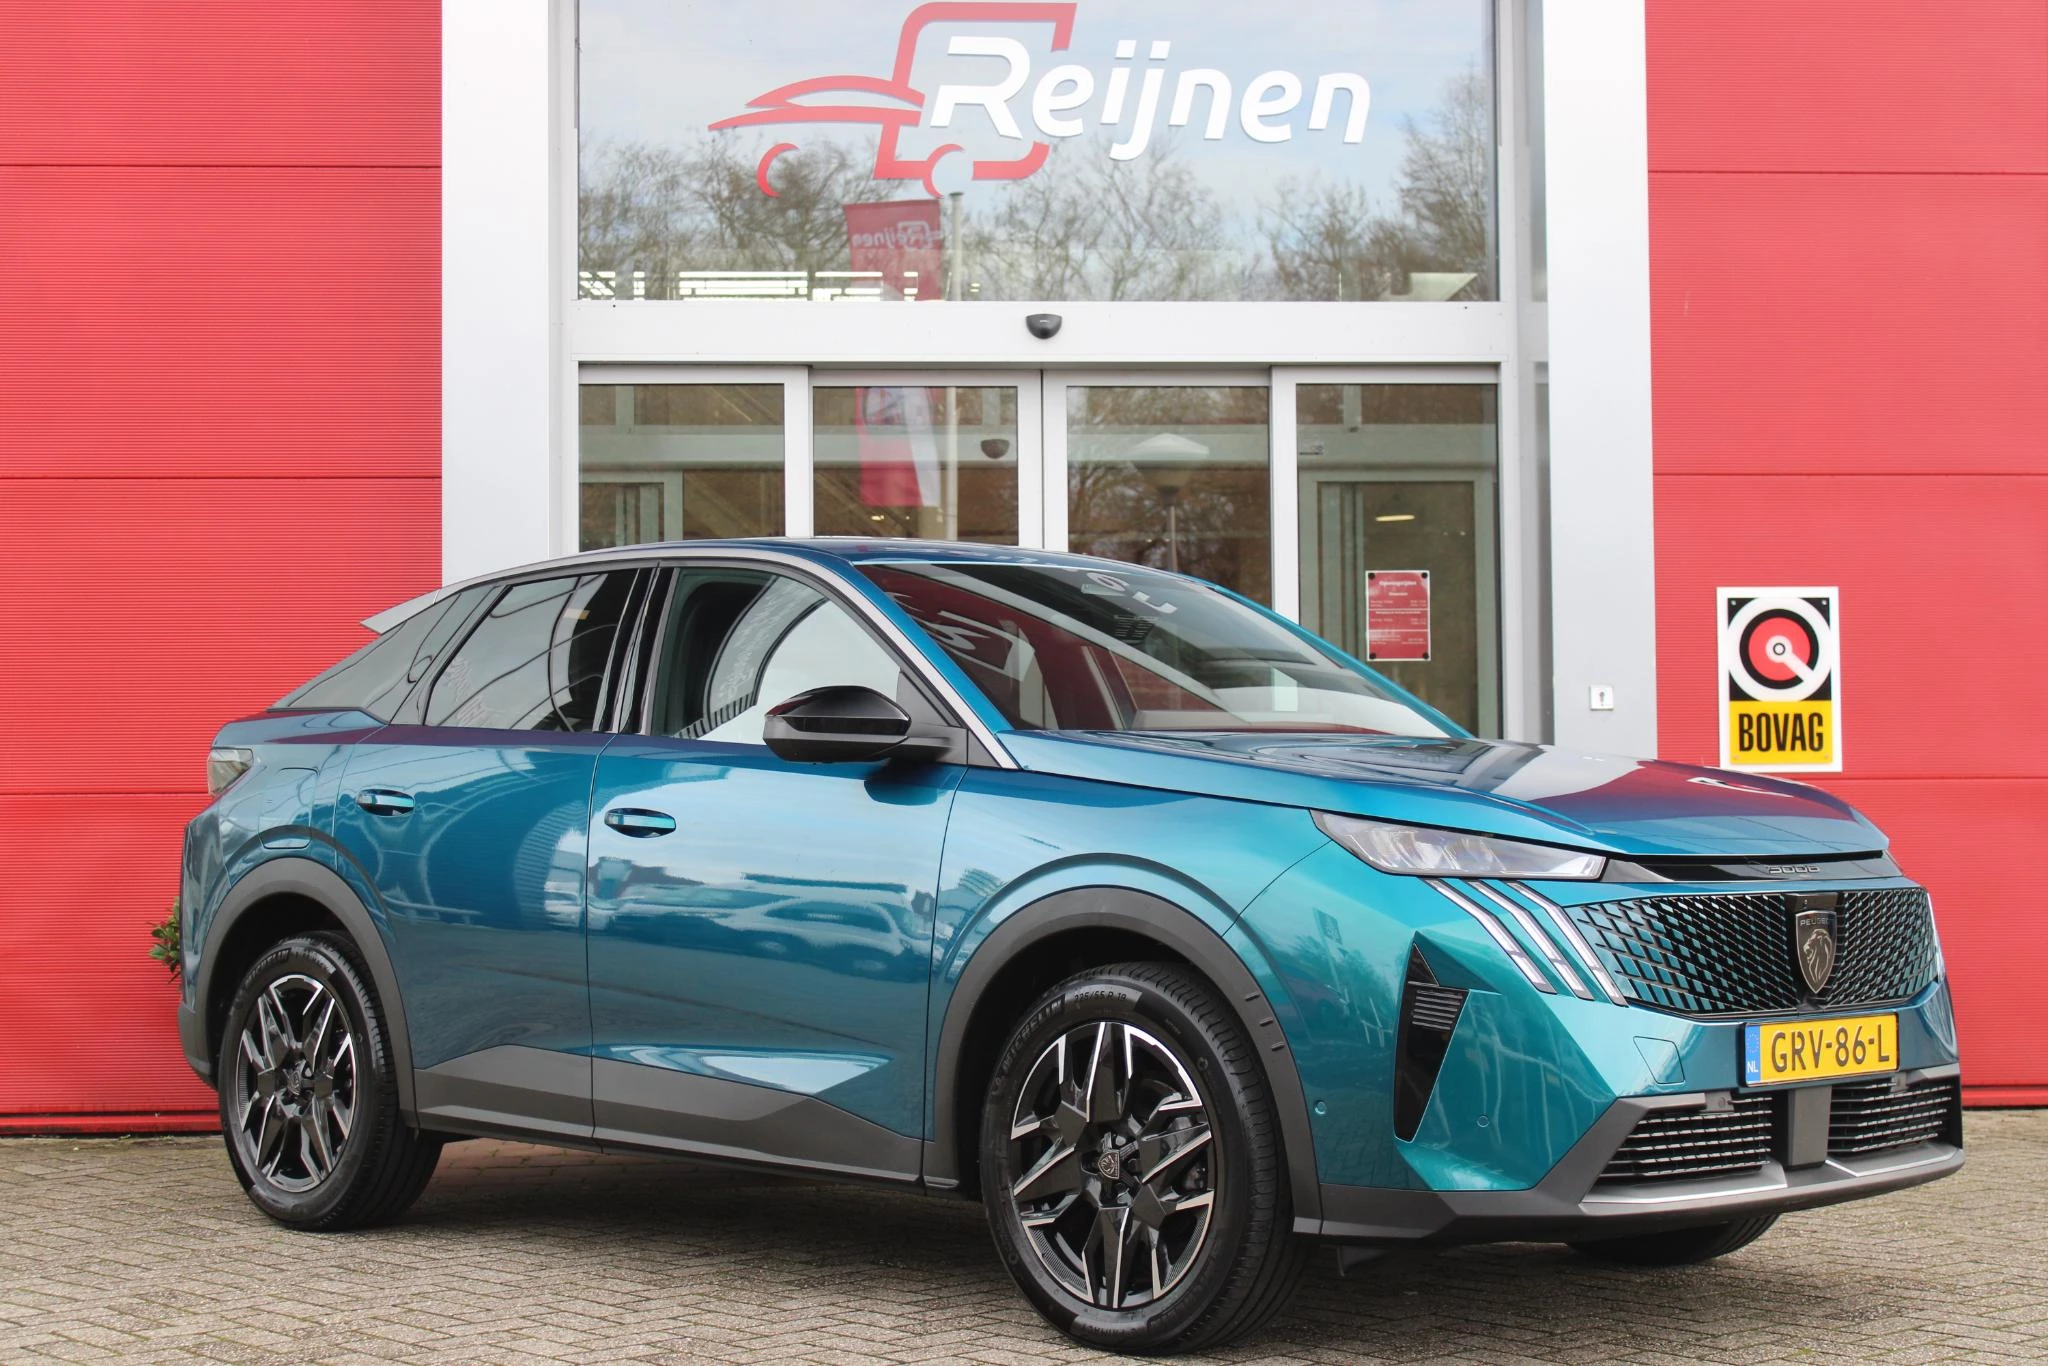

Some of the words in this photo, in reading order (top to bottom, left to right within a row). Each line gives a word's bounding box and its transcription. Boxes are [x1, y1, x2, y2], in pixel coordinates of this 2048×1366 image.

[929, 36, 1371, 161] Reijnen
[1738, 712, 1825, 752] BOVAG
[1747, 1060, 1759, 1073] NL
[1771, 1023, 1890, 1073] GRV-86-L
